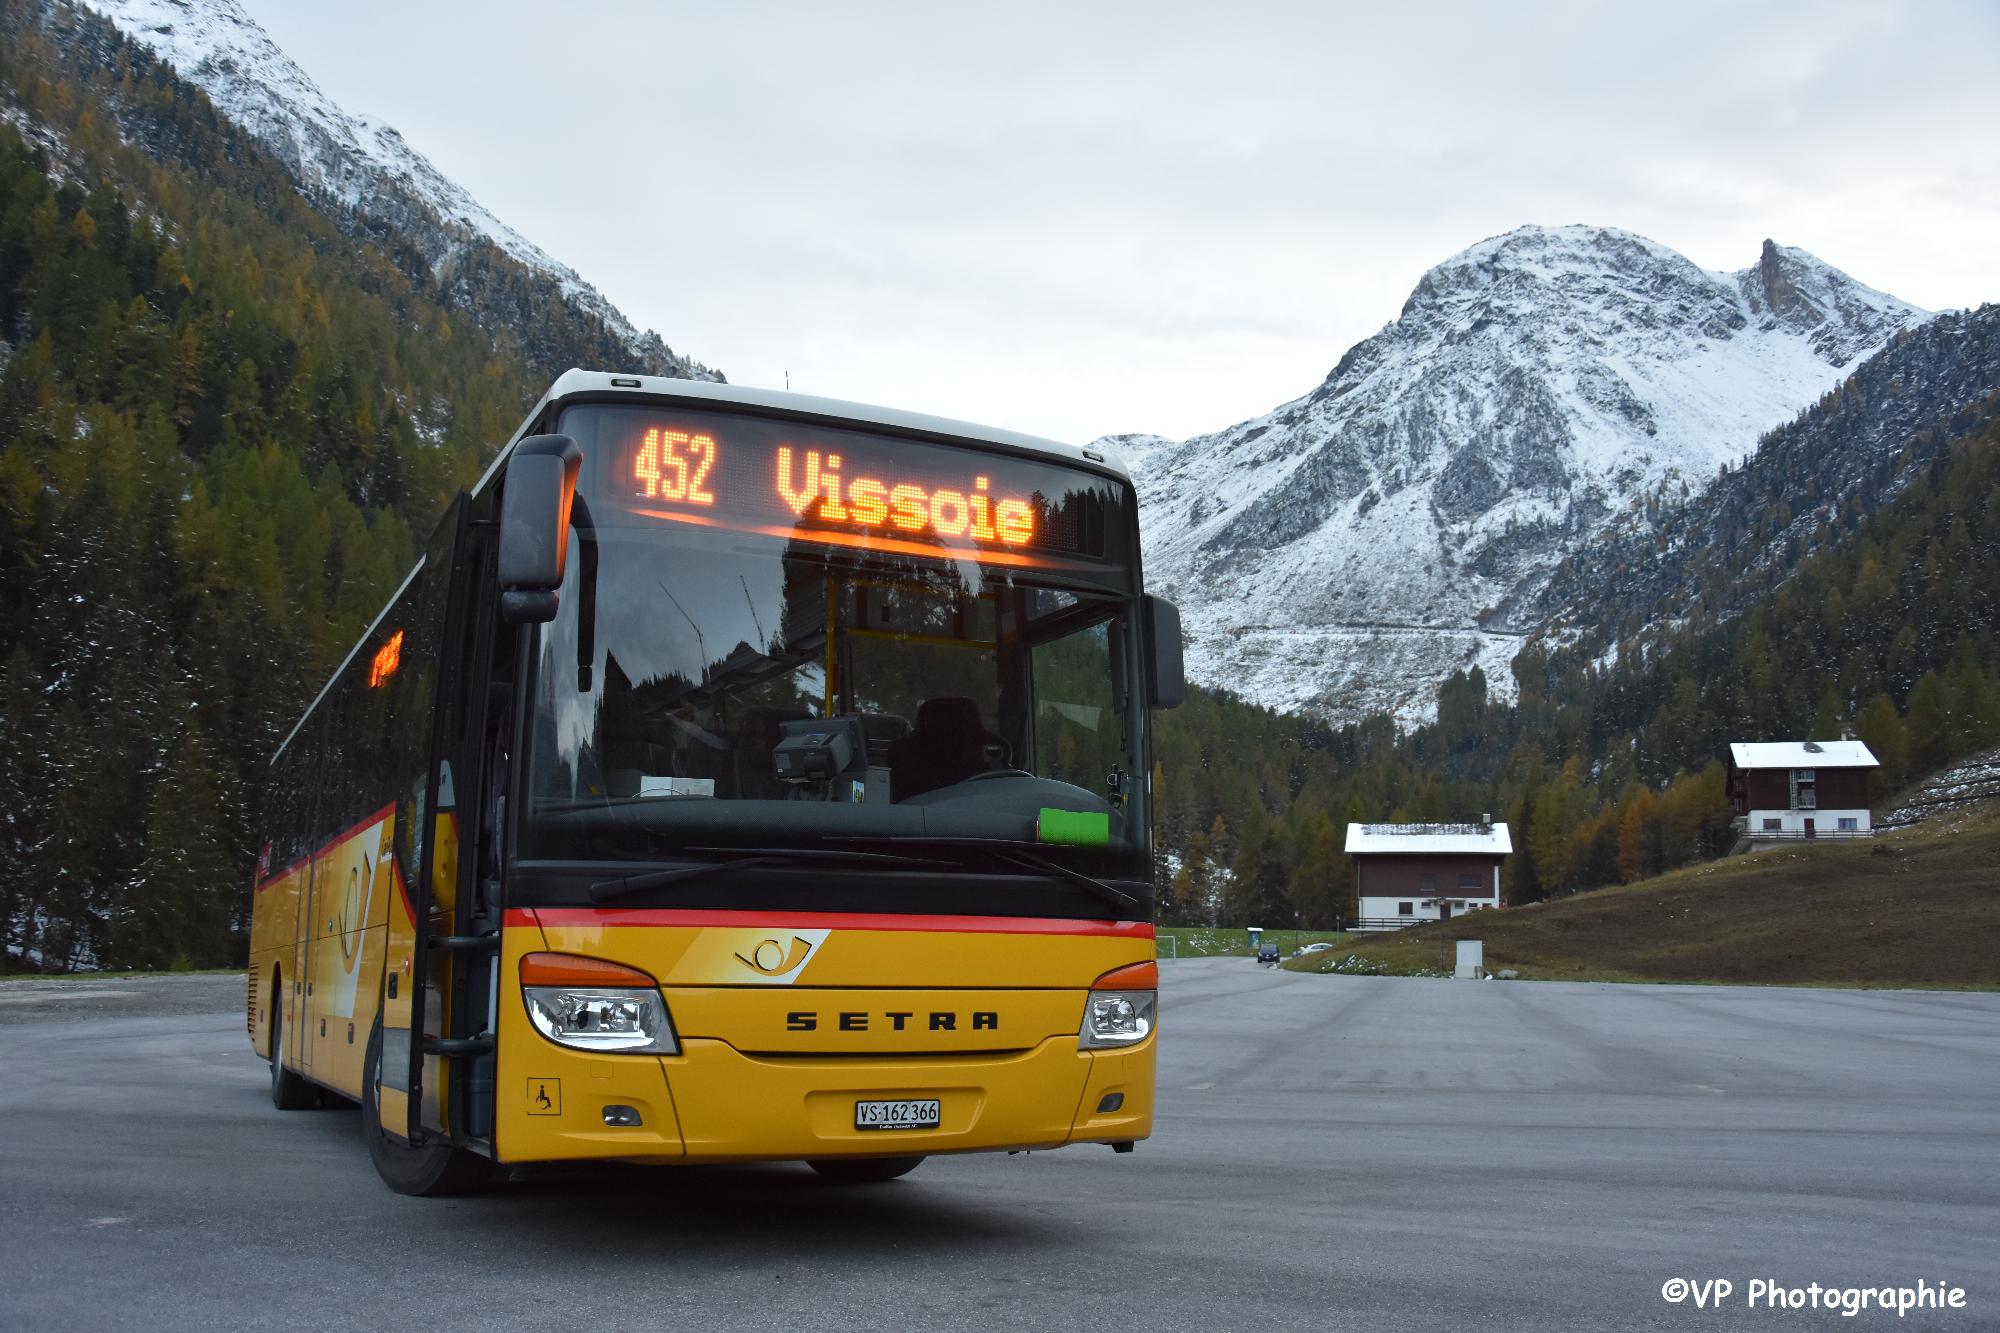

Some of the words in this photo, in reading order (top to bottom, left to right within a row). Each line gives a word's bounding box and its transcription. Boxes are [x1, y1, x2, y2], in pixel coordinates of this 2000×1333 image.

[635, 428, 715, 506] 452
[777, 447, 1034, 545] Vissoie
[786, 1011, 999, 1032] SETRA
